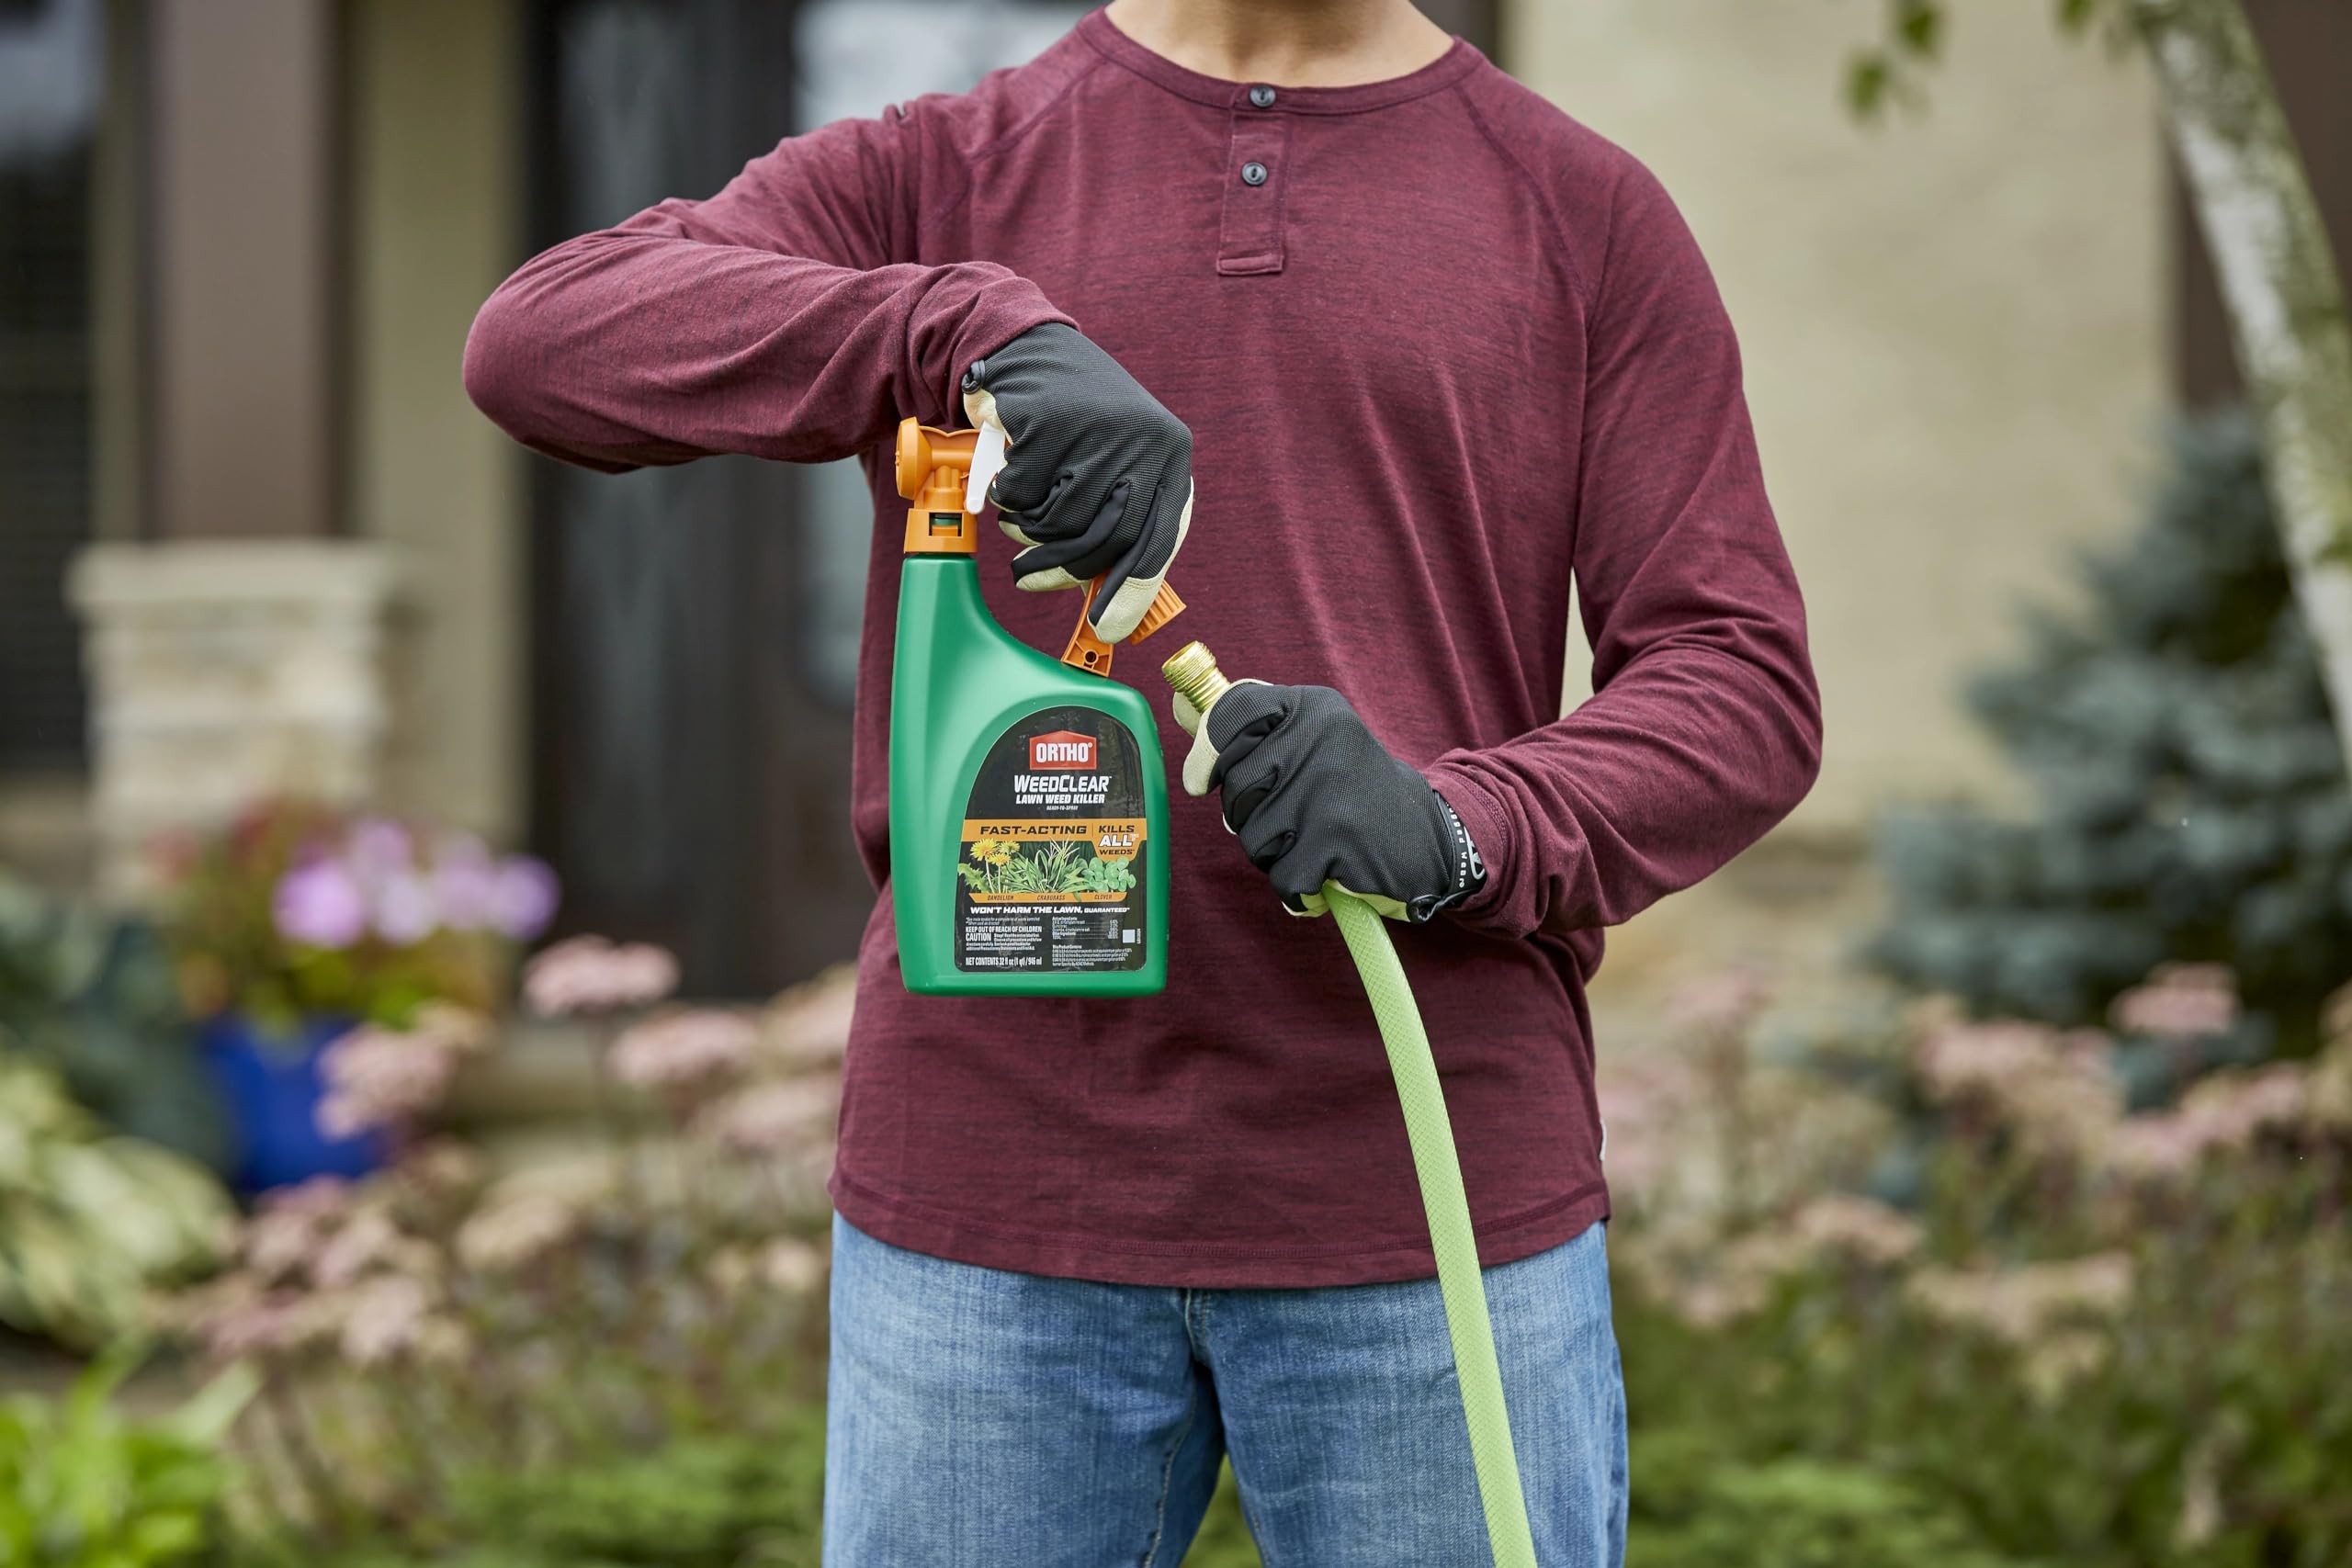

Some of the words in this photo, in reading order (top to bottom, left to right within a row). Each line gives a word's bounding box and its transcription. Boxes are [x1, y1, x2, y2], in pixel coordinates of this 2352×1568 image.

[1015, 794, 1043, 805] LAWN
[1045, 794, 1071, 805] WEED
[1073, 794, 1105, 805] KILLER
[979, 826, 1087, 835] FAST-ACTING
[1098, 825, 1136, 833] KILLS
[1098, 833, 1133, 847] ALL
[1053, 907, 1083, 915] LAWN,
[966, 932, 991, 942] CAUTION
[966, 957, 974, 965] NET
[975, 957, 999, 965] CONTENTS
[999, 957, 1005, 965] 32
